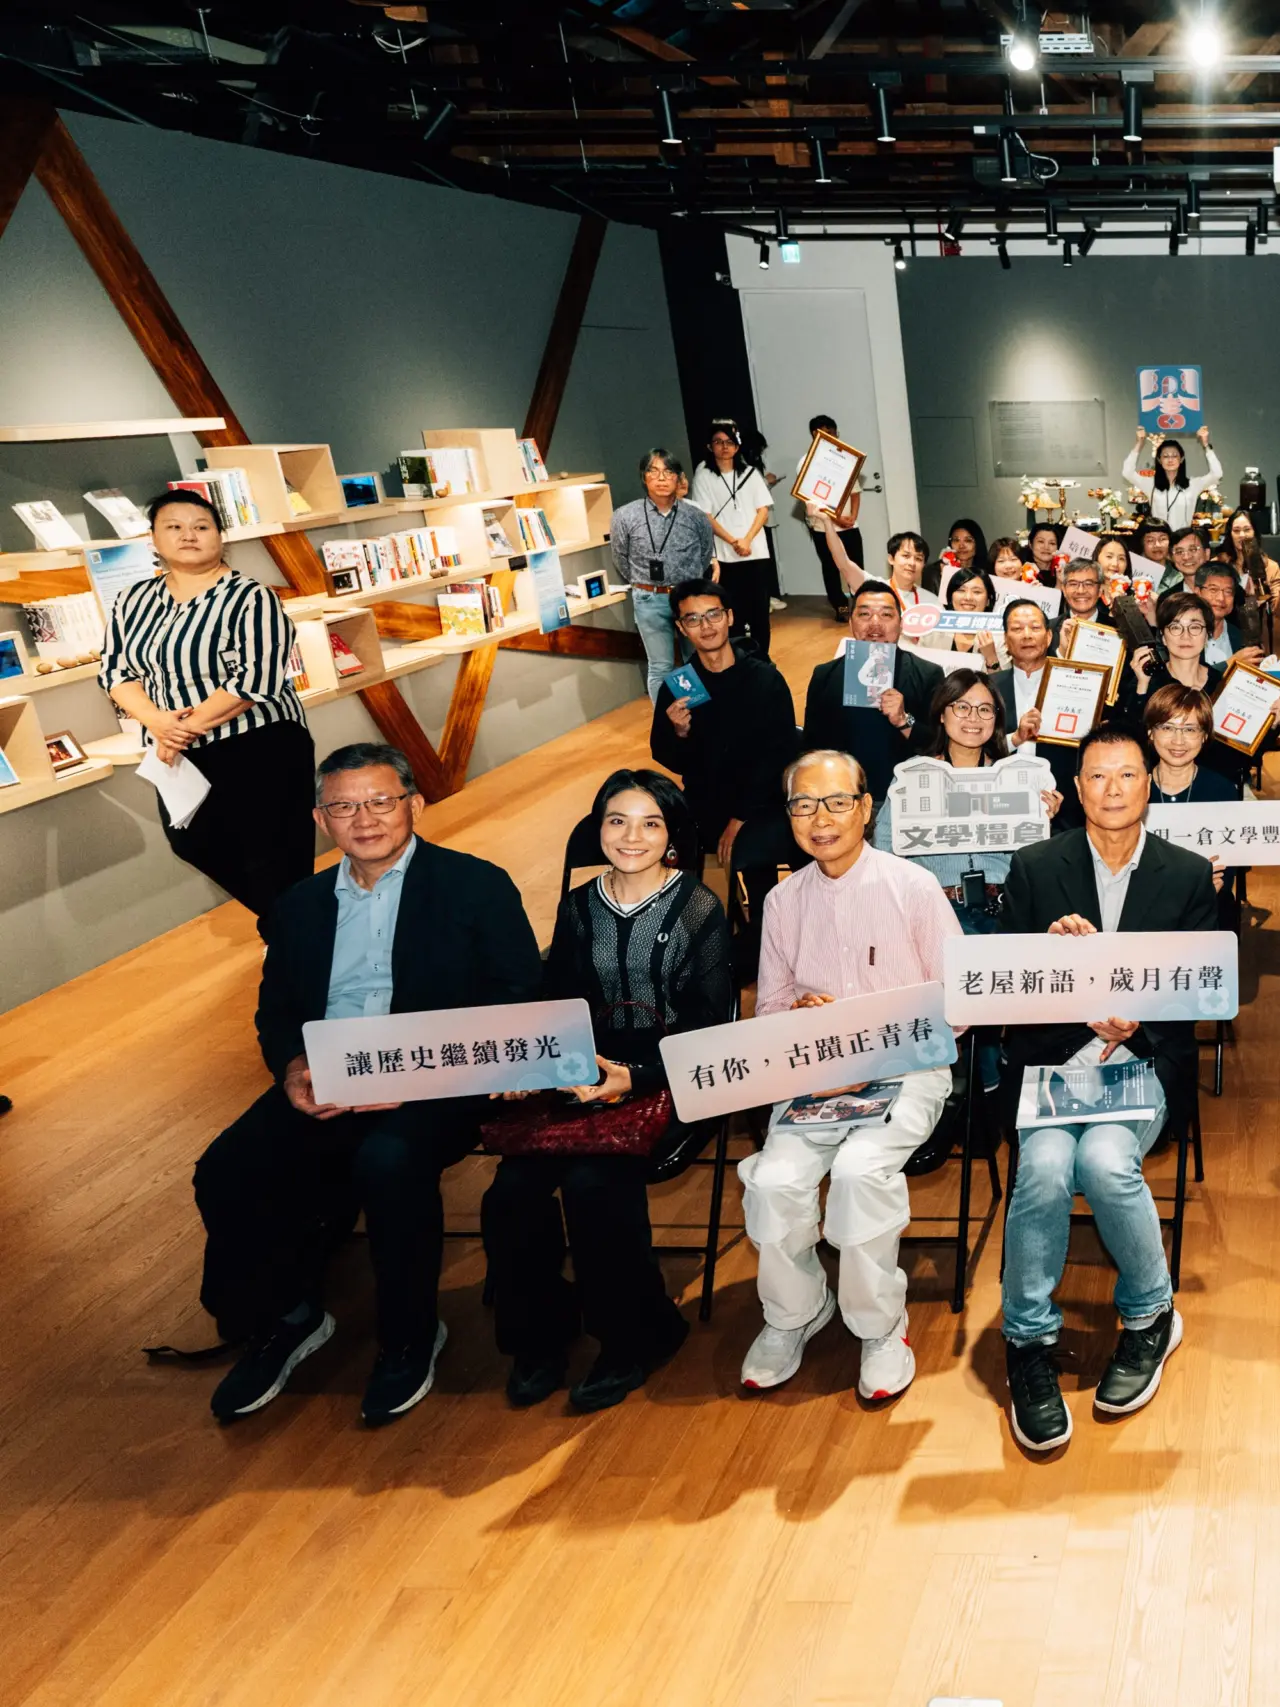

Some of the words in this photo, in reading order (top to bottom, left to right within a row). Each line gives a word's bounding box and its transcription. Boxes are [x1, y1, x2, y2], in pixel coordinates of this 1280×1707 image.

[903, 612, 937, 626] GO
[900, 821, 1045, 850] 文學糧倉
[959, 965, 1224, 996] 老屋新語，歲月有聲
[343, 1032, 562, 1077] 讓歷史繼續發光
[689, 1017, 935, 1091] 有你，古蹟正青春
